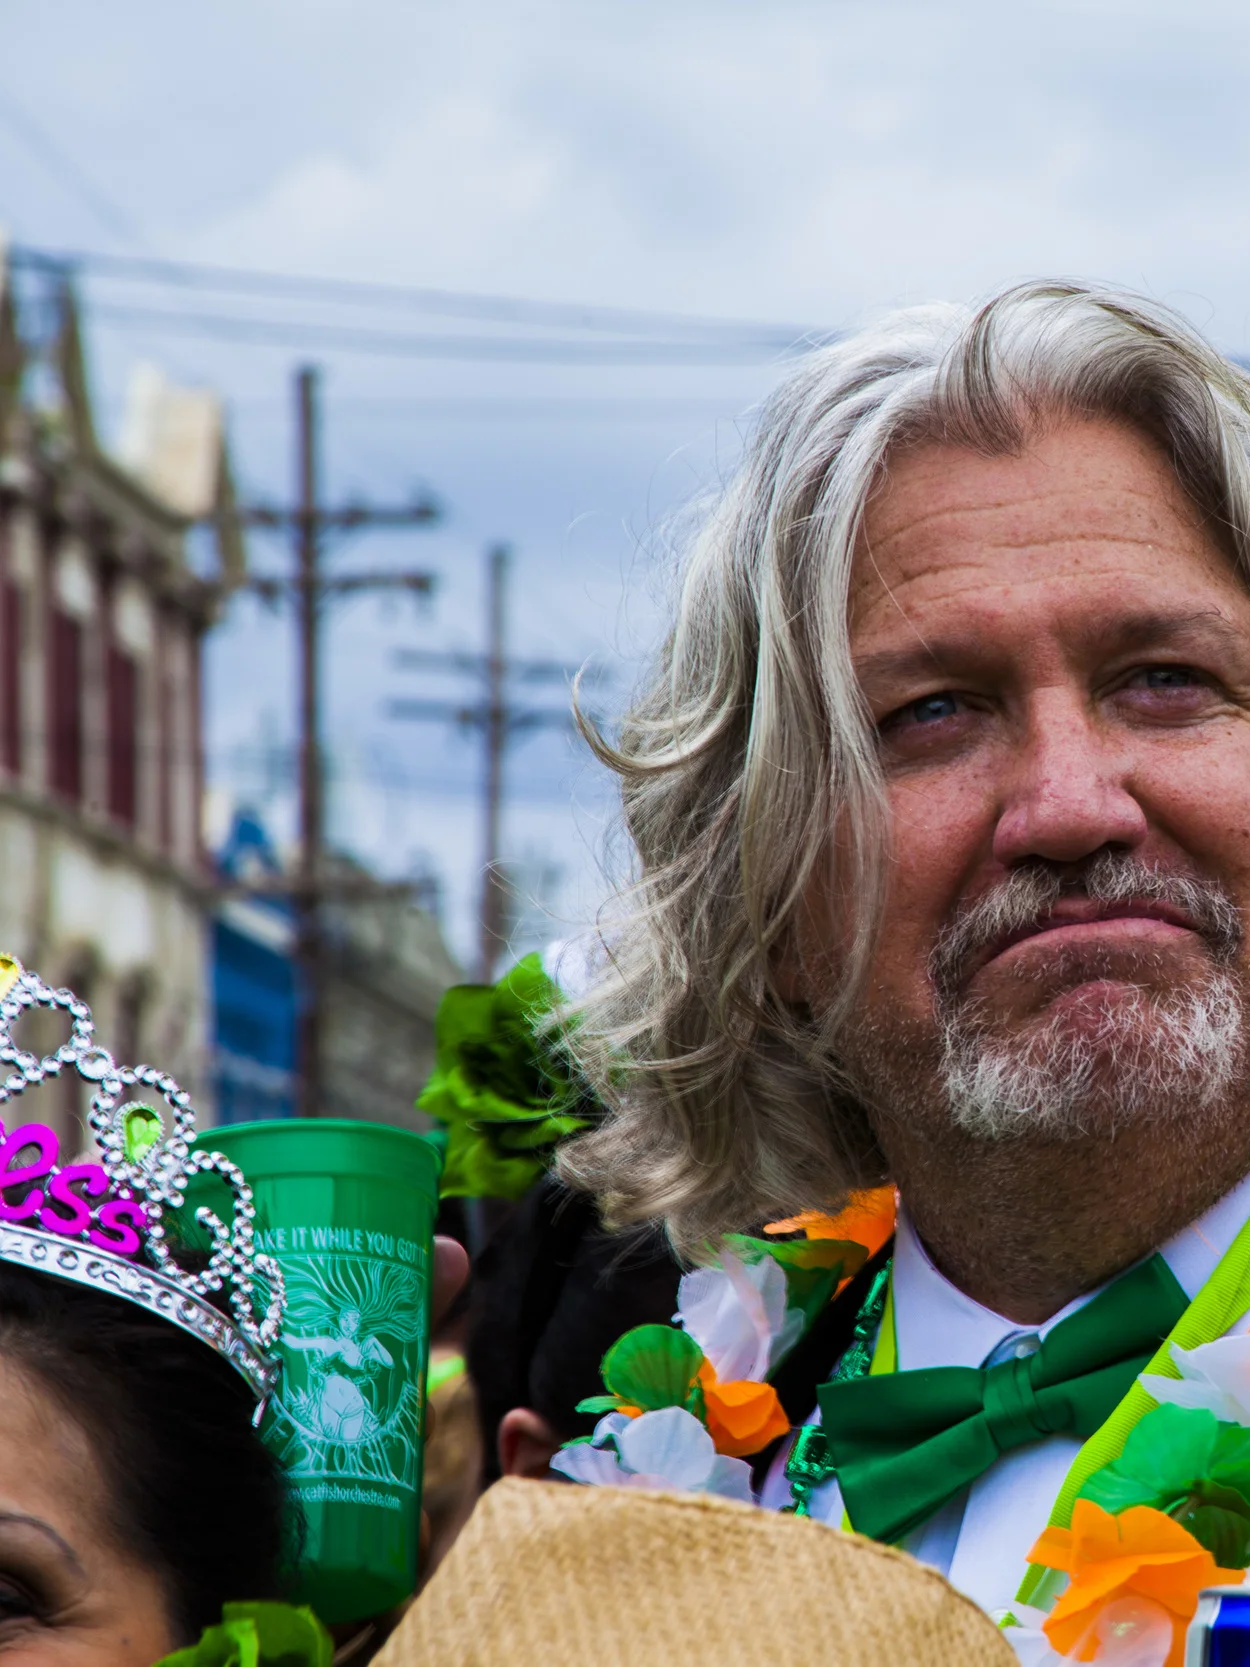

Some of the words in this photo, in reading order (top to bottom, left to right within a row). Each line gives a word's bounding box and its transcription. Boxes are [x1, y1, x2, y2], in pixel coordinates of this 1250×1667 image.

[0, 1115, 147, 1254] ess
[252, 1227, 287, 1253] AKE
[291, 1226, 307, 1250] IT
[310, 1226, 364, 1253] WHILE
[365, 1230, 396, 1258] YOU
